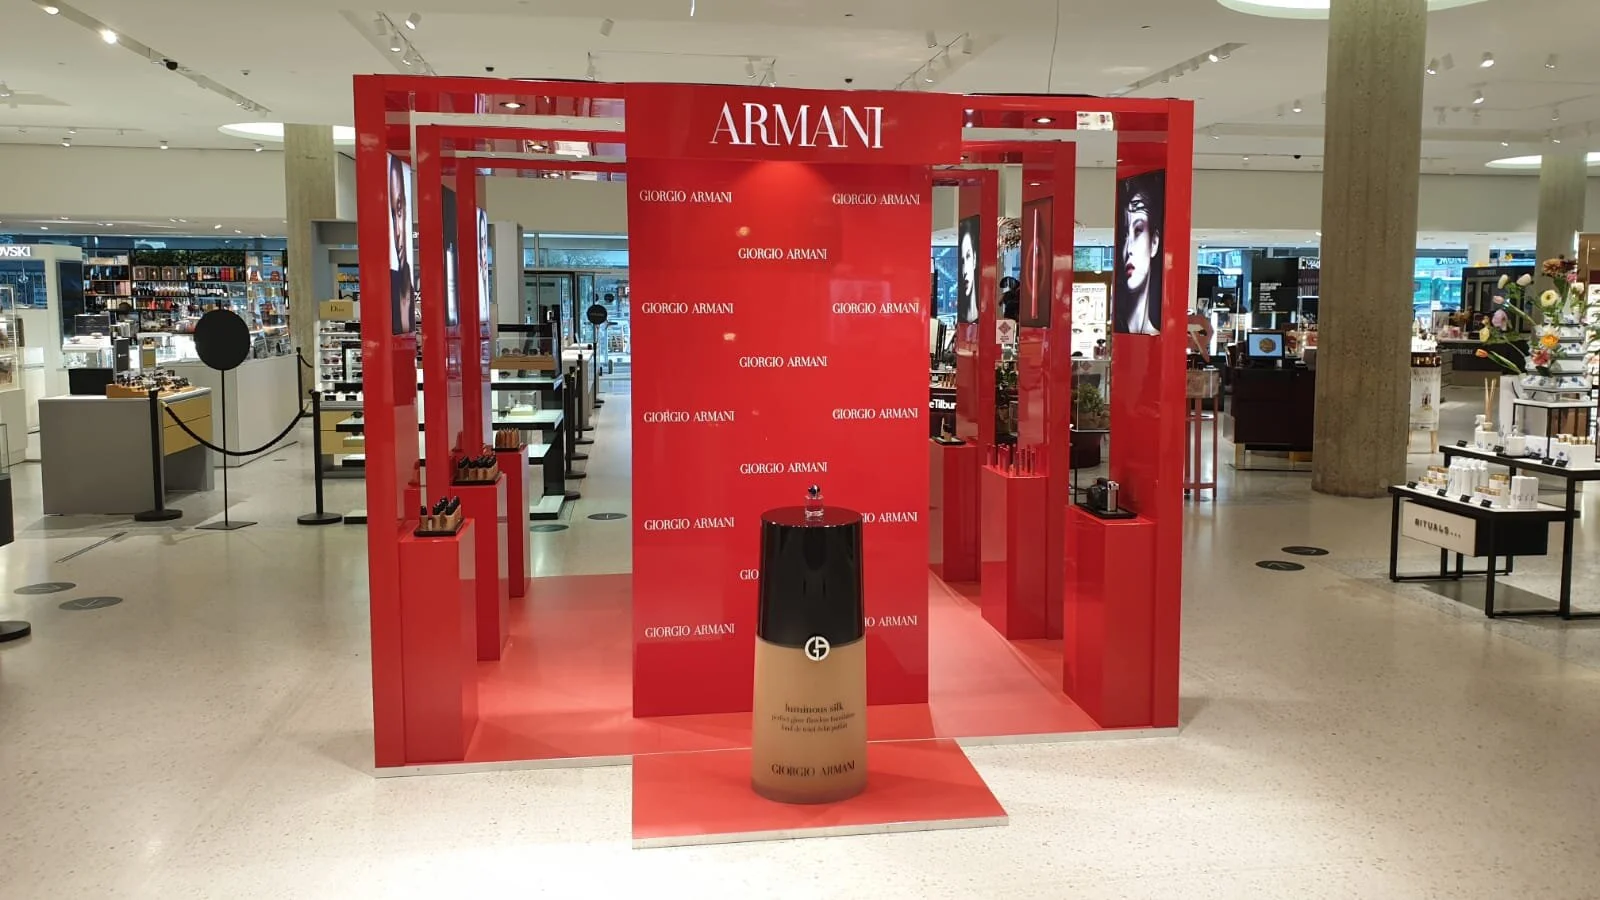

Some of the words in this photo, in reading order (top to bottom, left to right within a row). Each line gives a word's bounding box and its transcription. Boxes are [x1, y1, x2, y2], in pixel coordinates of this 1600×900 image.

[709, 101, 884, 150] ARMANI
[639, 190, 686, 203] GIORGIO
[689, 191, 733, 204] ARMANI
[832, 193, 877, 205] GIORGIO
[879, 193, 920, 206] ARMANI
[738, 247, 784, 260] GIORGIO
[786, 248, 827, 260] ARMANI
[641, 302, 688, 315] GIORGIO
[692, 302, 734, 314] ARMANI
[832, 302, 876, 314] GIORGIO
[879, 301, 919, 314] ARMANI
[739, 356, 784, 368] GIORGIO
[787, 355, 827, 368] ARMANI
[643, 411, 690, 423] GIORGIO
[693, 409, 735, 422] ARMANI
[832, 408, 876, 420] GIORGIO
[878, 407, 918, 420] ARMANI
[739, 462, 784, 475] GIORGIO
[787, 461, 828, 474] ARMANI
[643, 517, 690, 531] GIORGIO
[693, 515, 735, 529] ARMANI
[878, 511, 918, 523] ARMANI
[878, 615, 918, 627] ARMANI
[644, 625, 691, 638] GIORGIO
[694, 623, 735, 636] ARMANI
[785, 703, 828, 713] luminous
[830, 701, 844, 713] silk
[771, 763, 816, 777] GIORGIO
[822, 760, 855, 776] ARMANI
